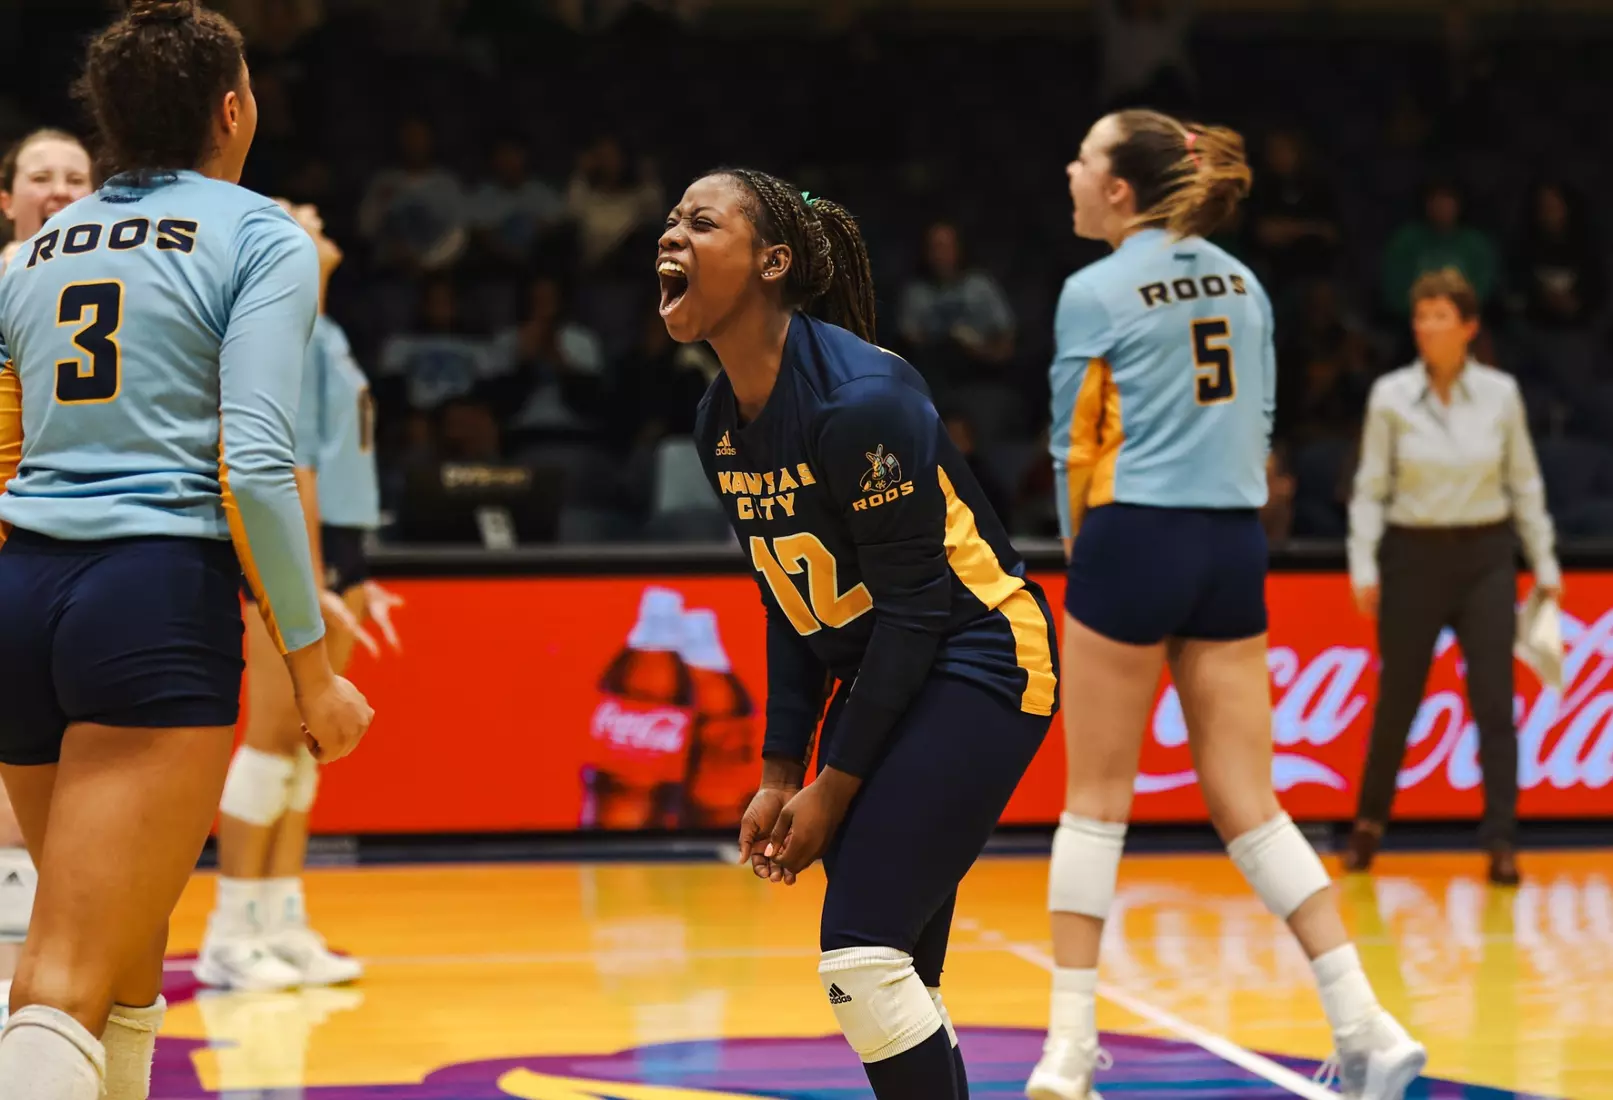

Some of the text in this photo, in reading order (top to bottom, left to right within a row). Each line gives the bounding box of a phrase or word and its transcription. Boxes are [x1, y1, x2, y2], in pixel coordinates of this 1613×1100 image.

[26, 217, 198, 269] ROOS
[1137, 273, 1248, 308] ROOS
[55, 278, 125, 405] 3
[1190, 316, 1237, 407] 5
[715, 445, 737, 456] adas
[736, 492, 795, 521] CTY
[852, 480, 914, 512] ROOS
[750, 532, 874, 636] 12
